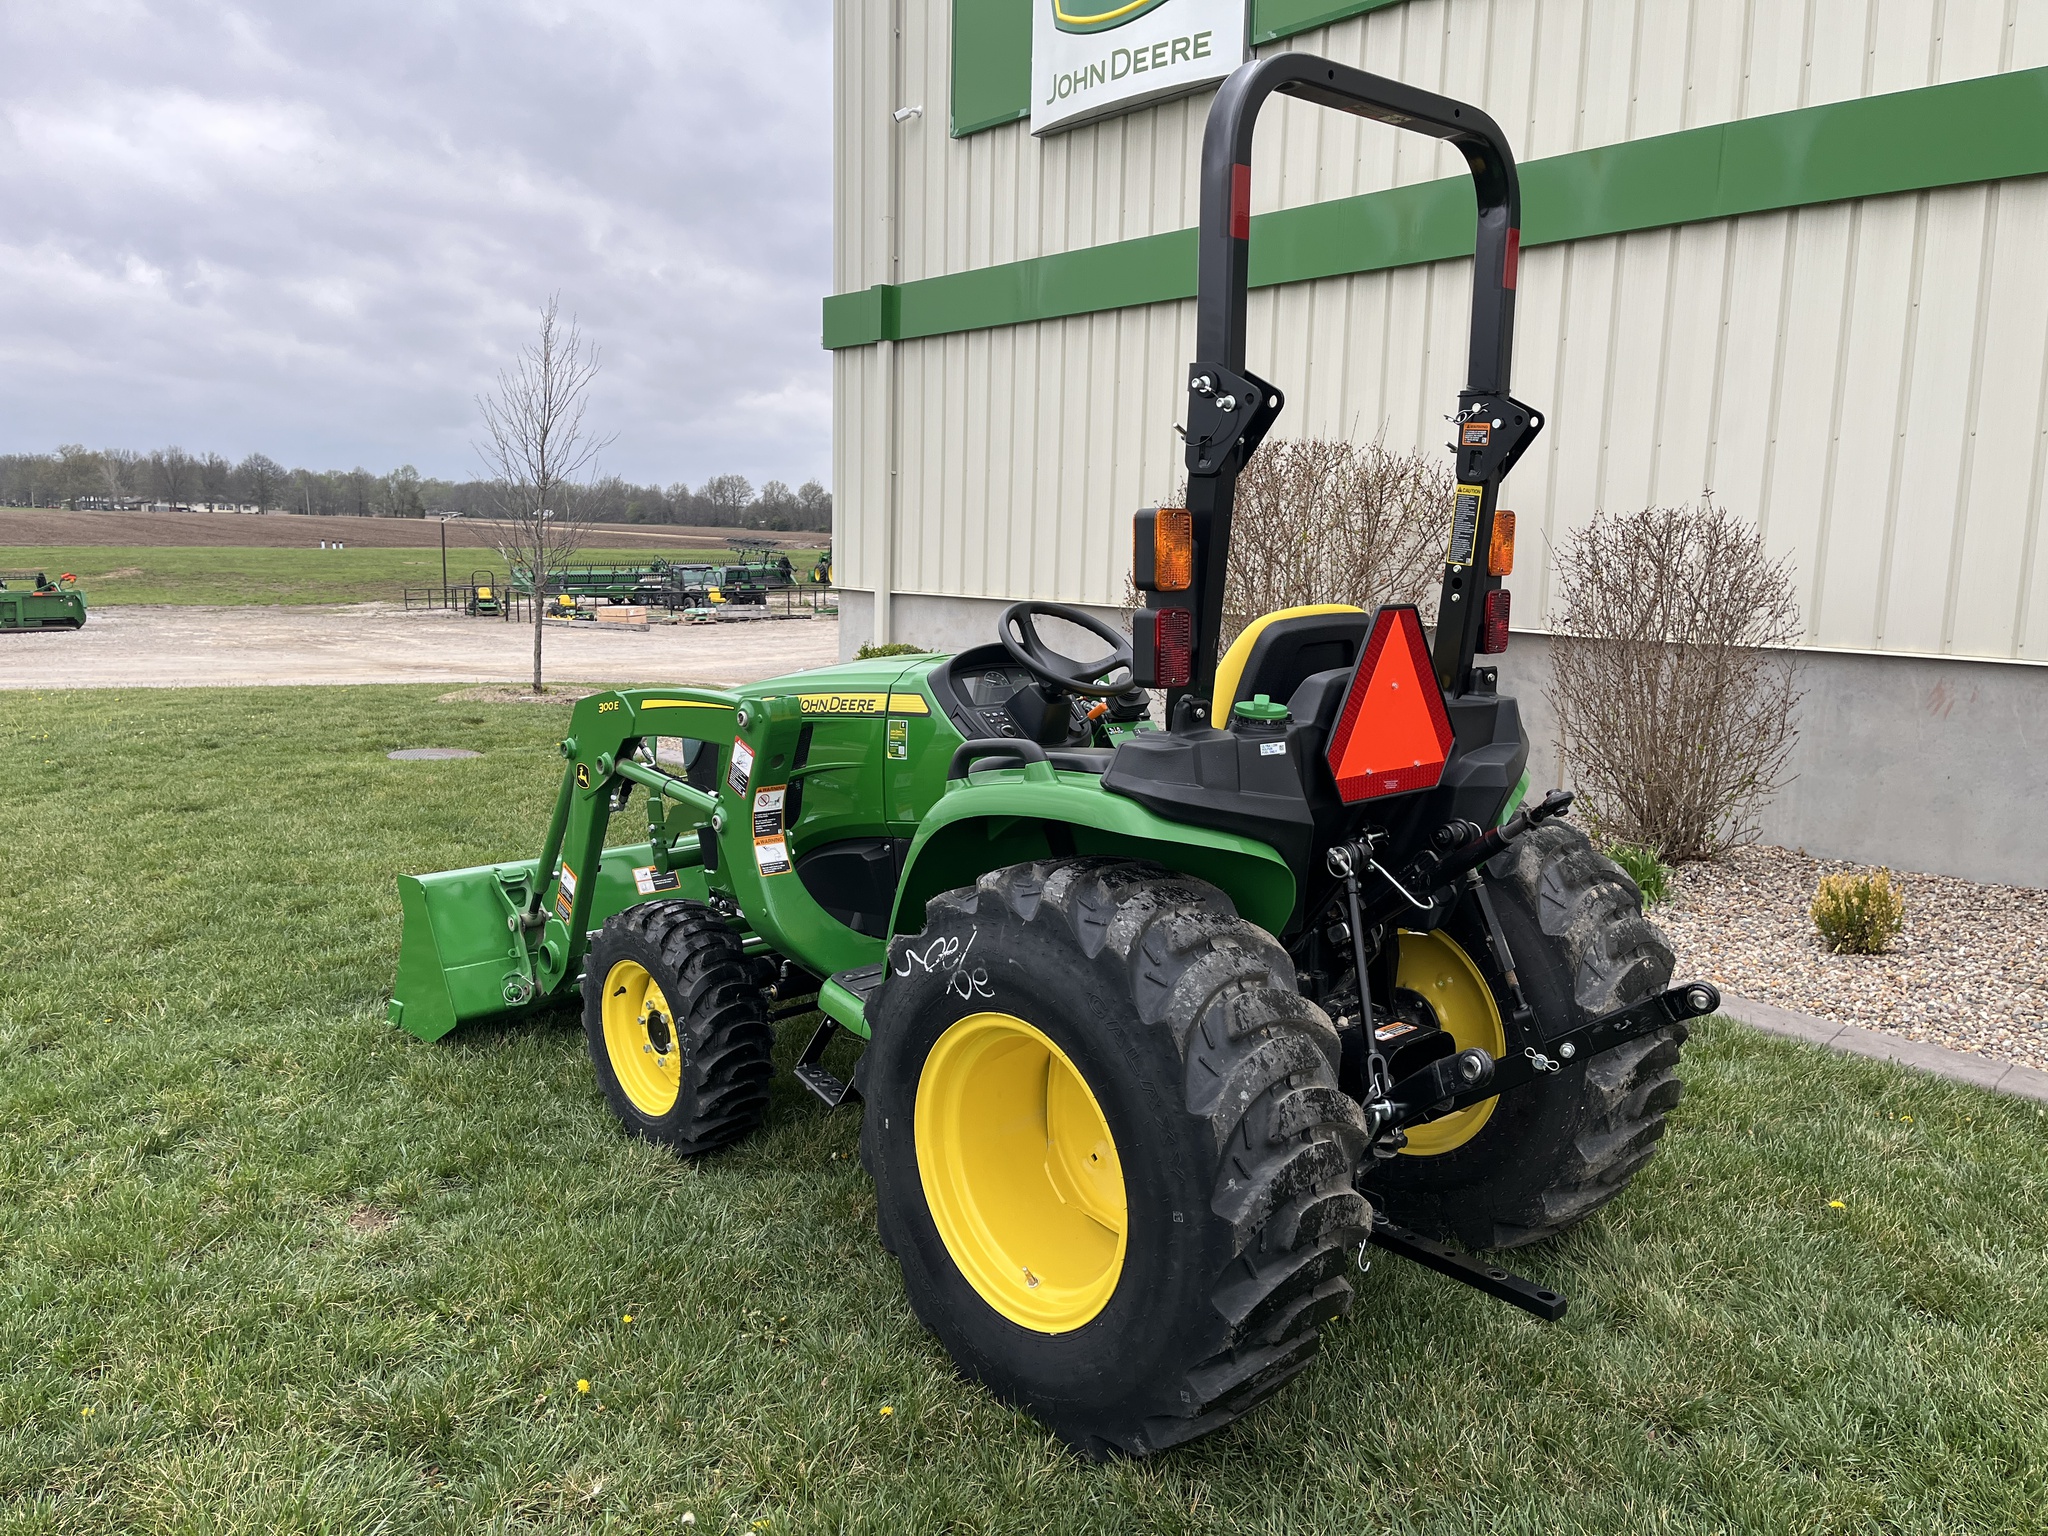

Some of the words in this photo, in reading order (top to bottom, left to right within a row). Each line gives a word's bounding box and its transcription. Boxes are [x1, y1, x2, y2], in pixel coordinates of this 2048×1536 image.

[1046, 60, 1106, 105] JOHN
[1111, 30, 1213, 81] DEERE
[829, 696, 877, 711] DEERE
